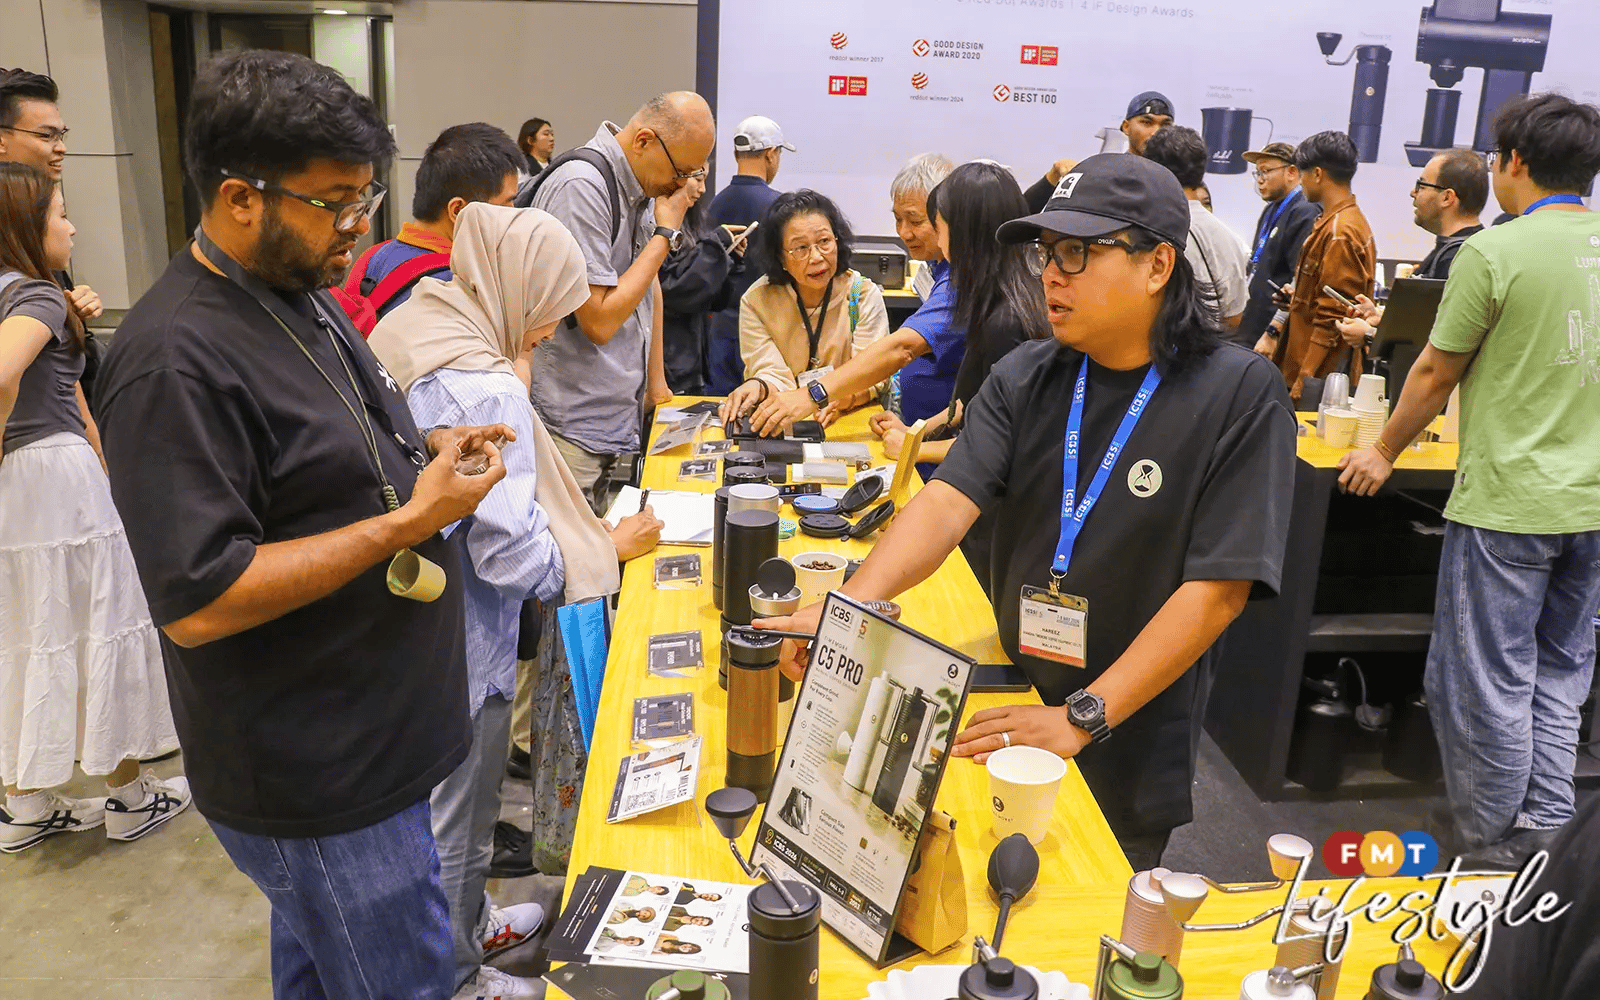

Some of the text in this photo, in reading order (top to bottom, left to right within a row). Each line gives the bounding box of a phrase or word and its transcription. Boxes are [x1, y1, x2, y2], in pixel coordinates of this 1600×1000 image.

[1107, 2, 1147, 16] Design
[1151, 5, 1194, 18] Awards
[933, 40, 984, 50] GOOD DESIGN
[933, 50, 981, 60] AWARD 2020
[1013, 92, 1057, 104] BEST 100
[1076, 377, 1085, 400] ICBS
[1128, 391, 1147, 417] ICBS
[1068, 430, 1078, 455] ICBS
[1101, 445, 1118, 470] ICBS
[1065, 489, 1074, 513] ICBS
[1073, 498, 1091, 522] ICBS
[830, 604, 851, 622] ICBS
[859, 619, 869, 635] 5
[817, 644, 864, 686] C5 PRO
[773, 839, 786, 852] ICBS
